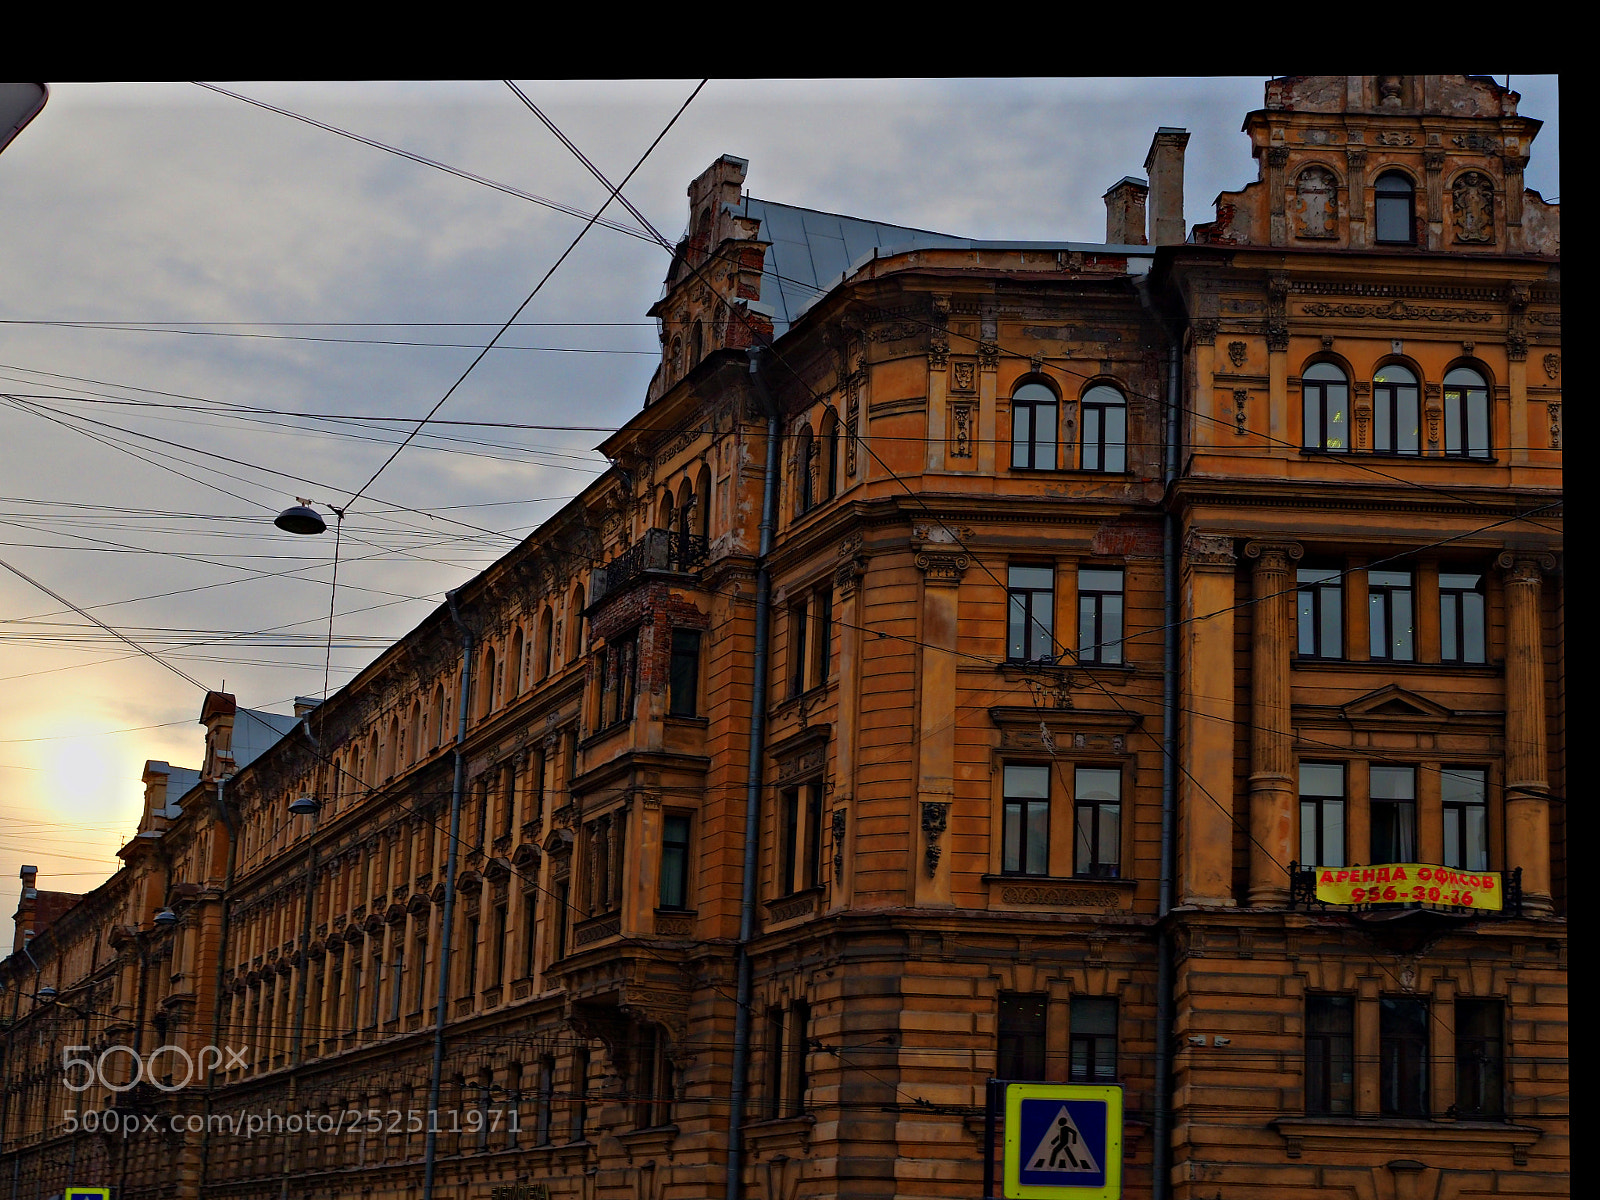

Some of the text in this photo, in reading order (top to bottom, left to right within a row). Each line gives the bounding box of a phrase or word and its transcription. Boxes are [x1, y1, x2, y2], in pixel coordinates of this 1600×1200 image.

[1320, 867, 1495, 889] АРЕНДА ОФИСОВ
[1352, 885, 1473, 907] 956-30-36
